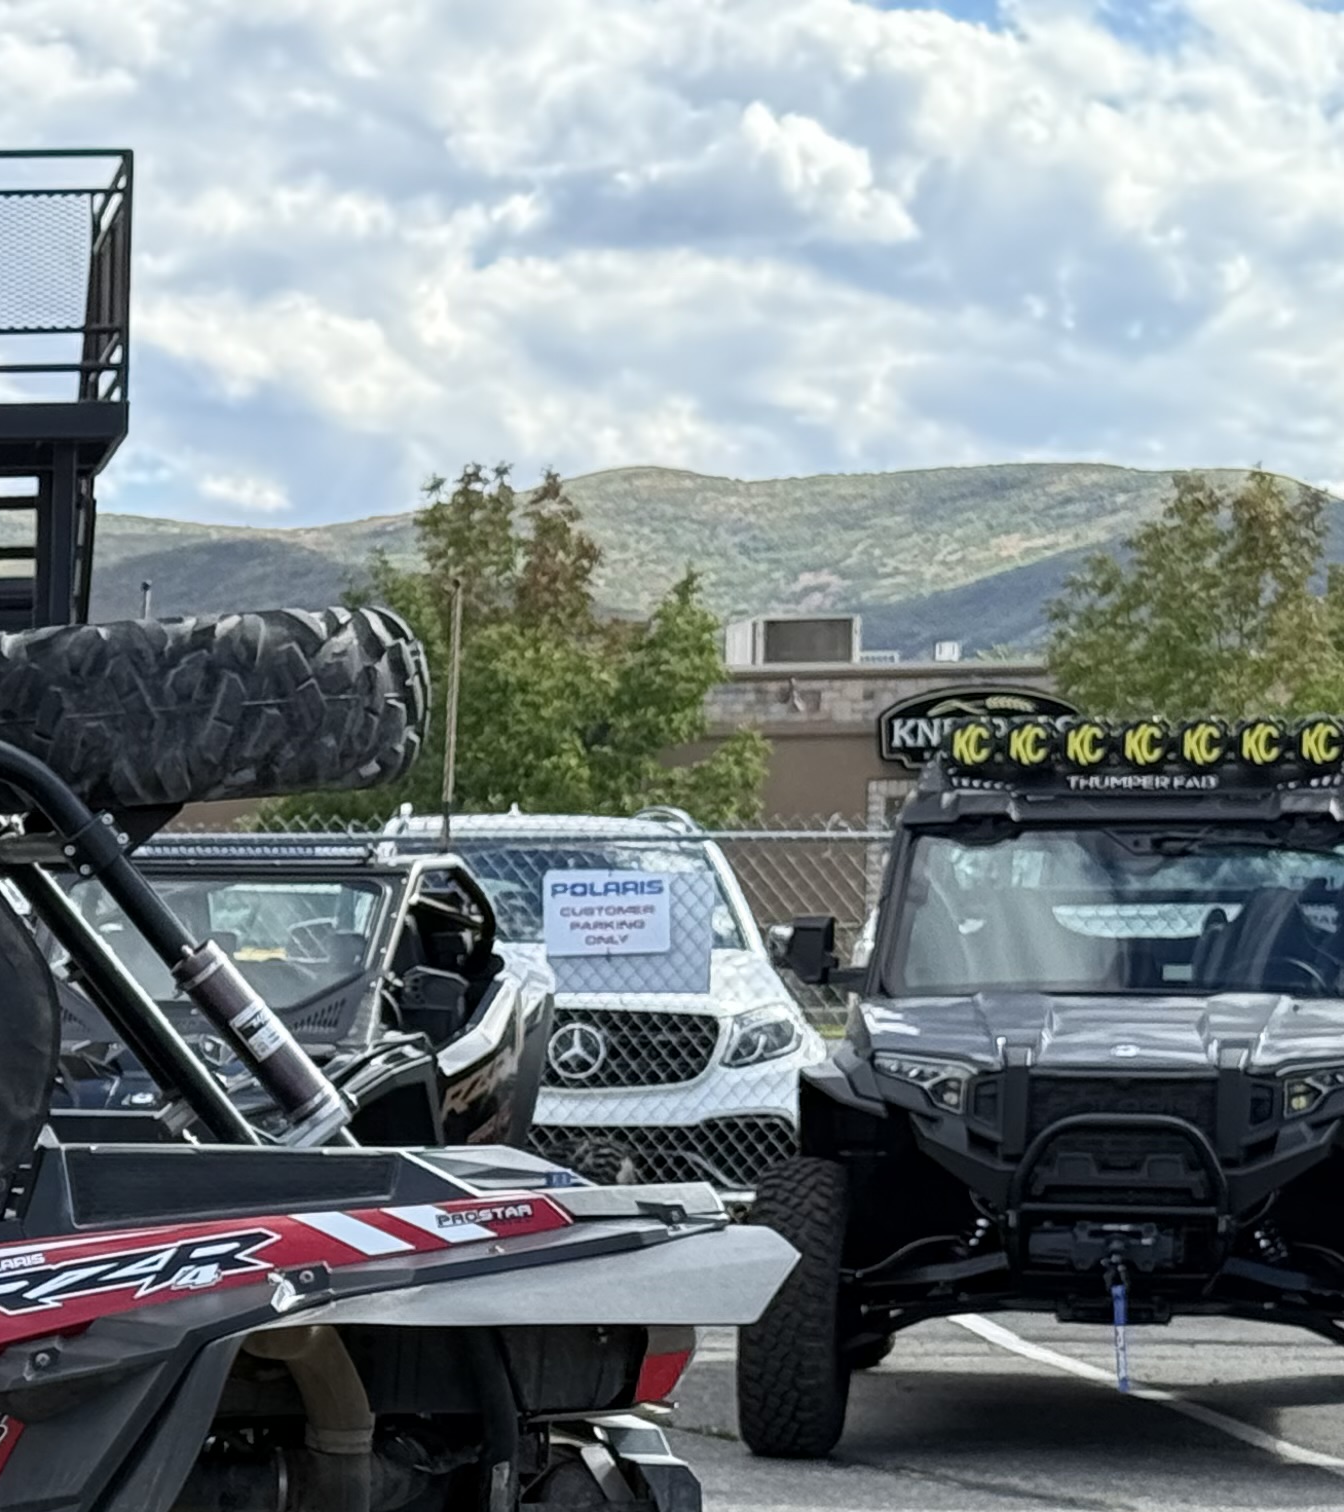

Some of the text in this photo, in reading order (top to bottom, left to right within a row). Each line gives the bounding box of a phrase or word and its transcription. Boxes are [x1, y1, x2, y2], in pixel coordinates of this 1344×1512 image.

[953, 723, 991, 766] KC
[1010, 723, 1048, 766] KC
[1067, 723, 1105, 766] KC
[1124, 723, 1163, 766] KC
[1183, 723, 1222, 766] KC
[1242, 723, 1281, 766] KC
[1302, 723, 1341, 766] KC
[1067, 775, 1170, 790] THUMPER
[551, 880, 664, 897] POLARIS
[560, 905, 655, 917] CUSTOMER
[570, 919, 645, 931] PARKING
[585, 934, 629, 945] ONLY
[436, 1204, 533, 1228] PROSTAR
